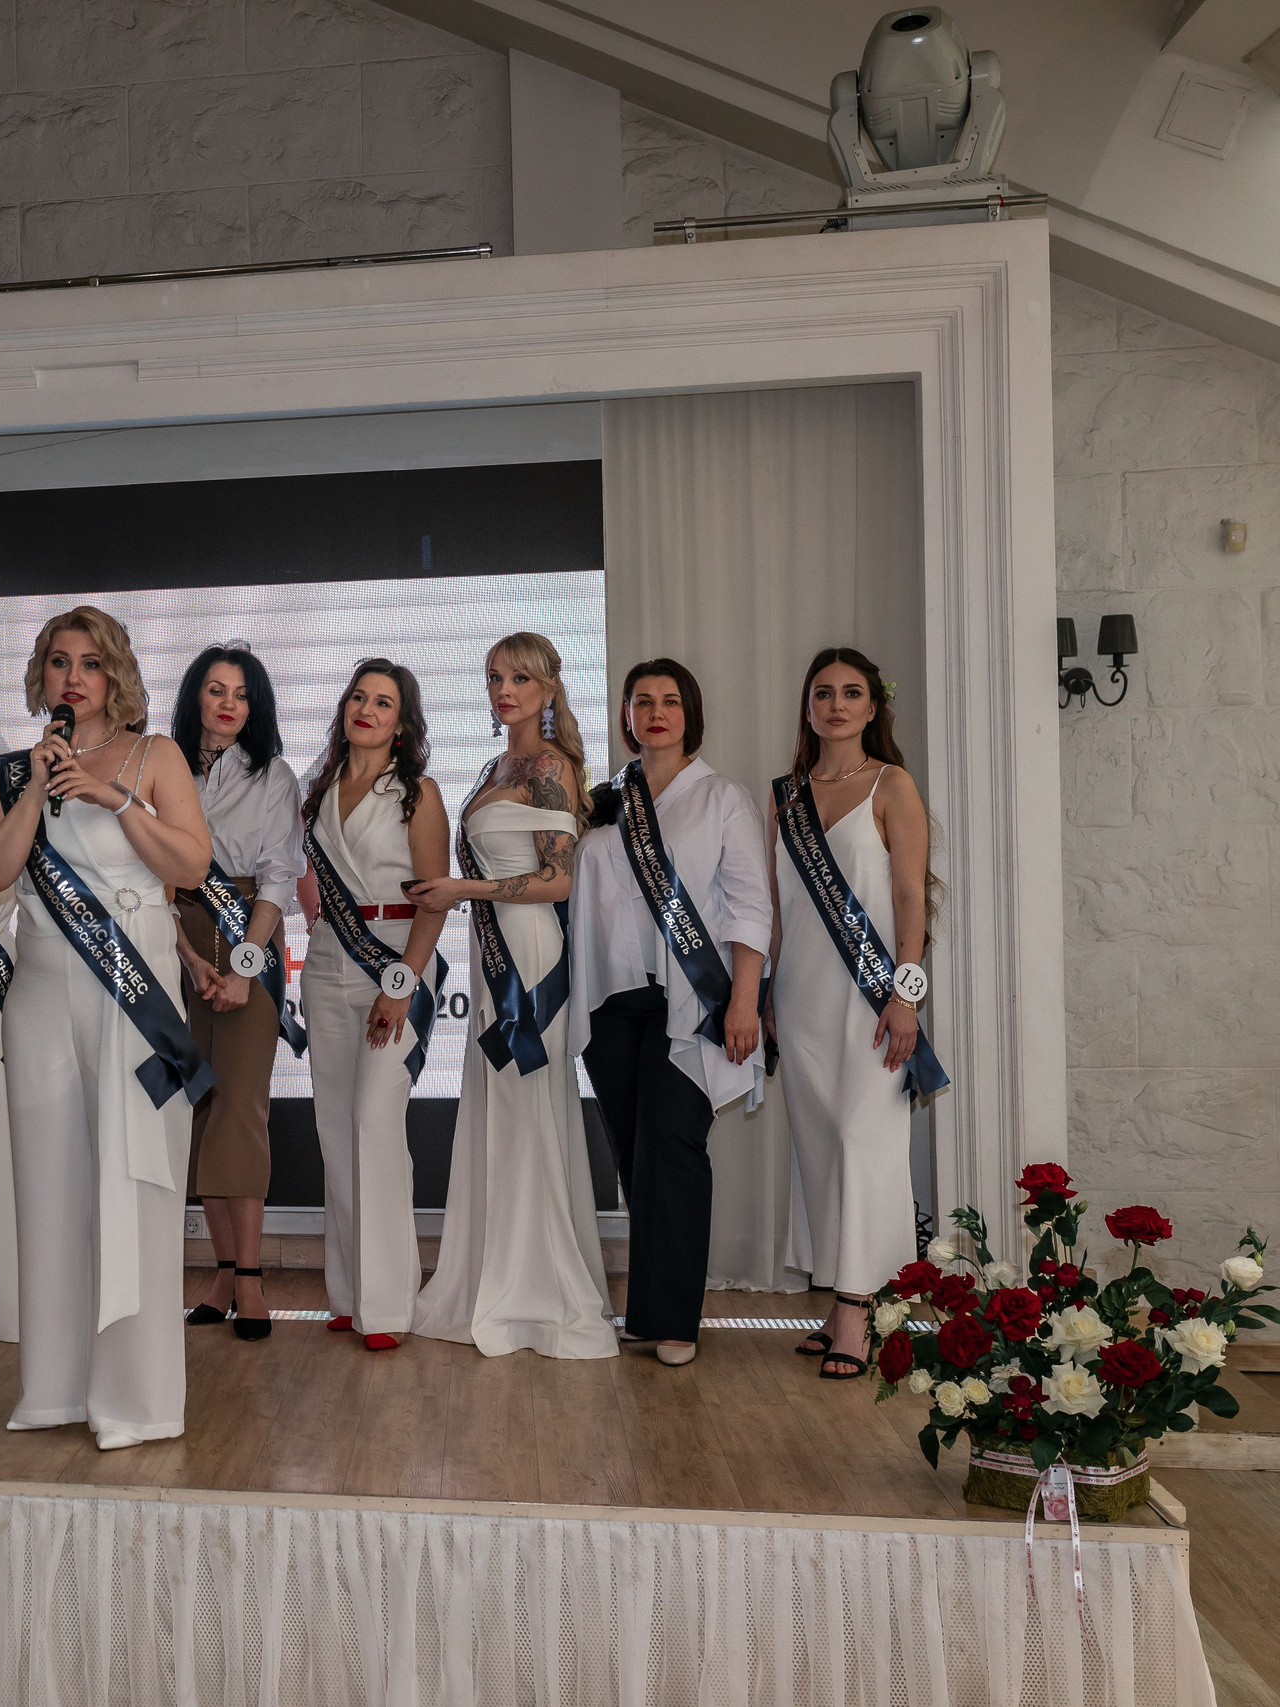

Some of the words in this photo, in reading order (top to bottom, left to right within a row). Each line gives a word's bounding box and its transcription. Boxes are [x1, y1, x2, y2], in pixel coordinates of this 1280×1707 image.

[786, 808, 813, 870] НОВОСИБИРСК
[208, 875, 248, 924] МИССИС
[304, 832, 347, 912] ФИНАЛИСТКА
[343, 909, 381, 957] МИССИС
[630, 836, 666, 913] НОВОСИБИРСКАЯ
[662, 911, 690, 956] ОБЛАСТЬ
[644, 843, 675, 898] МИССИС
[668, 897, 703, 950] БИЗНЕС
[795, 802, 832, 886] ФИНАЛИСТКА
[828, 884, 867, 941] МИССИС
[860, 941, 894, 992] БИЗНЕС
[809, 868, 818, 878] И
[57, 880, 109, 942] МИССИС
[104, 939, 149, 996] БИЗНЕС
[199, 881, 244, 938] ВОСИБИРСКАЯ
[329, 904, 381, 970] НОВОСИБИРСКАЯ
[813, 876, 858, 957] НОВОСИБИРСКАЯ
[37, 877, 104, 961] НОВОСИБИРСКАЯ
[100, 958, 137, 1005] ОБЛАСТЬ
[241, 951, 255, 969] 8
[485, 922, 506, 974] БИЗНЕС
[391, 971, 405, 990] 9
[854, 954, 884, 999] ОБЛАСТЬ
[896, 967, 924, 996] 13
